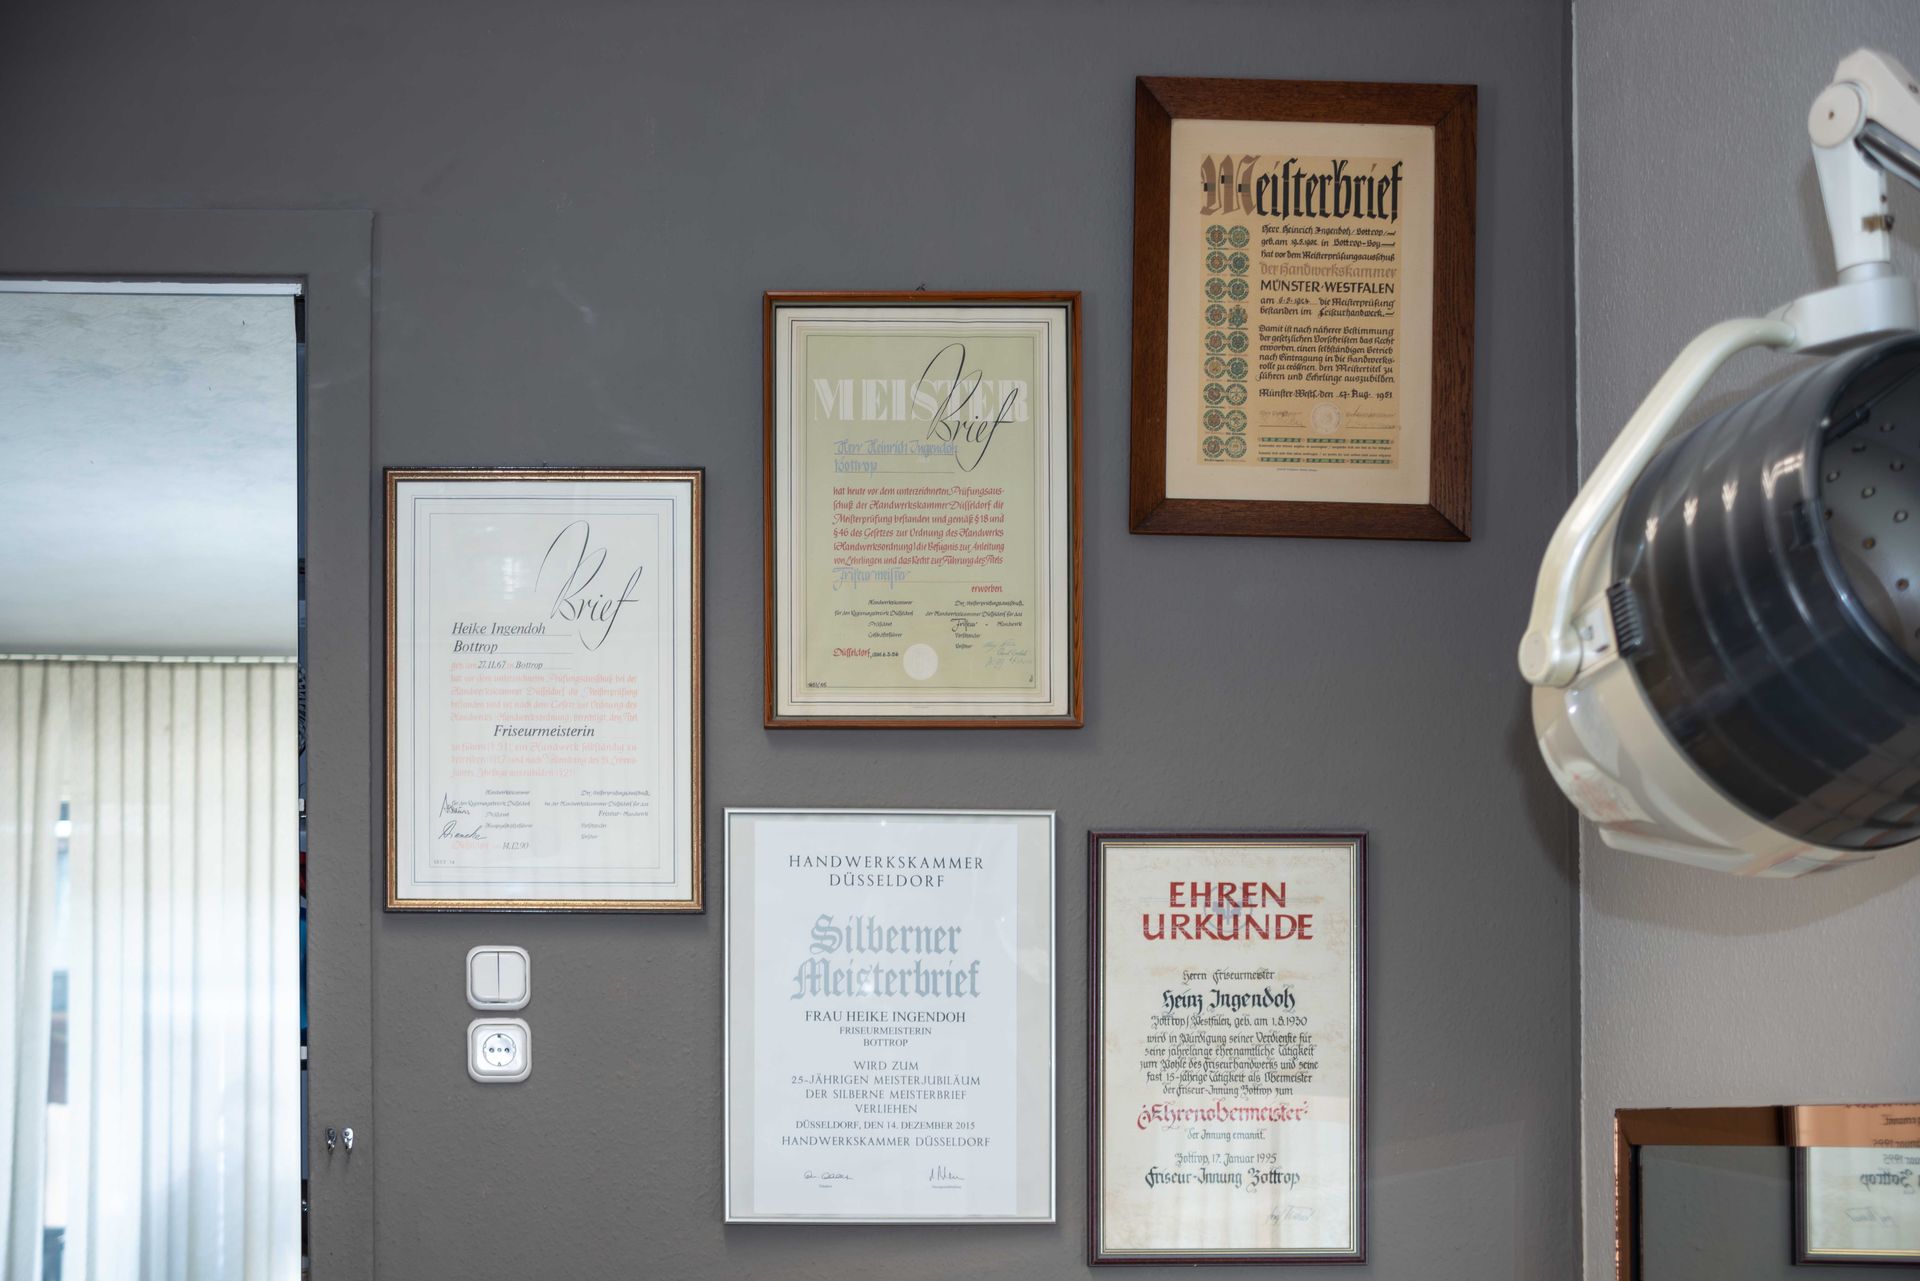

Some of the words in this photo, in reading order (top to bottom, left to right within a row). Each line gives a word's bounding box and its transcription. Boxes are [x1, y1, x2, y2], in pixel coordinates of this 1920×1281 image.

[1200, 155, 1403, 224] Meisterbrief
[1261, 250, 1273, 260] hat
[1260, 262, 1279, 274] der
[1280, 263, 1397, 277] Handwerkskammer
[1332, 299, 1395, 307] Meisterprüfung
[1301, 307, 1311, 315] im
[1294, 325, 1311, 335] nach
[1313, 326, 1341, 335] näherer
[1343, 327, 1394, 336] Bestimmung
[1271, 335, 1312, 344] gesetzlichen
[1314, 336, 1357, 344] Vorschriften
[1375, 337, 1394, 345] Recht
[1259, 354, 1277, 363] nach
[1279, 355, 1323, 363] Eintragung
[1257, 373, 1285, 381] führen
[813, 379, 1030, 422] MEISTER
[912, 343, 1018, 472] Brief
[833, 486, 845, 495] hat
[847, 486, 865, 495] heute
[879, 486, 895, 495] dem
[856, 500, 867, 509] der
[870, 500, 946, 511] Handwerkskammer
[947, 500, 991, 511] Düsseldorf
[993, 500, 1004, 509] die
[833, 514, 892, 525] Meisterprüfung
[894, 514, 930, 523] bestanden
[931, 514, 946, 523] und
[946, 514, 974, 525] gemäß
[989, 514, 1004, 523] und
[850, 528, 862, 536] des
[895, 530, 907, 539] zur
[909, 528, 944, 539] Ordnung
[946, 528, 958, 536] des
[958, 528, 1004, 536] Handwerks
[916, 542, 927, 550] die
[927, 542, 959, 553] Befugnis
[960, 544, 970, 553] zur
[535, 519, 643, 651] Brief
[452, 621, 487, 635] Heike
[490, 621, 546, 638] Ingendoh
[453, 640, 498, 656] Bottrop
[515, 660, 543, 672] Bottrop
[493, 724, 595, 737] Friseurmeisterin
[789, 856, 984, 869] HANDWERKSKAMMER
[829, 873, 945, 887] DÜSSELDORF
[1169, 882, 1286, 907] EHREN
[1142, 914, 1313, 940] URKUNDE
[809, 913, 962, 955] Silberner
[790, 957, 981, 1000] Meisterbrief
[1182, 968, 1207, 984] Herrn
[1212, 968, 1275, 984] Friseurmeister
[1162, 988, 1203, 1012] Heinz
[1207, 988, 1296, 1012] Ingendoh
[805, 1011, 842, 1022] FRAU
[846, 1011, 888, 1022] HEIKE
[892, 1011, 966, 1022] INGENDOH
[1254, 1018, 1268, 1026] am
[839, 1027, 932, 1035] FRISEURMEISTERIN
[863, 1038, 908, 1047] BOTTROP
[1147, 1032, 1166, 1043] wird
[1169, 1032, 1177, 1043] in
[1179, 1032, 1227, 1046] Würdigung
[1229, 1032, 1254, 1043] seiner
[1256, 1032, 1297, 1043] Verdienste
[1299, 1032, 1312, 1046] für
[1145, 1045, 1165, 1056] seine
[1167, 1045, 1213, 1058] jahrelange
[1215, 1045, 1275, 1058] ehrenamtliche
[1278, 1045, 1315, 1058] Tätigkeit
[853, 1061, 887, 1070] WIRD
[892, 1061, 919, 1070] ZUM
[1140, 1062, 1157, 1072] zum
[1160, 1060, 1186, 1072] Wohle
[1188, 1060, 1202, 1069] des
[1203, 1060, 1278, 1072] Friseurhandwerks
[1280, 1060, 1296, 1069] und
[1298, 1060, 1319, 1069] seine
[792, 1074, 869, 1084] 25-JÄHRIGEN
[874, 1074, 981, 1085] MEISTERJUBILÄUM
[1146, 1073, 1162, 1082] fast
[1208, 1073, 1246, 1084] Tätigkeit
[1248, 1073, 1261, 1082] als
[1264, 1073, 1313, 1082] Obermeister
[805, 1089, 828, 1099] DER
[833, 1090, 884, 1099] SILBERNE
[889, 1090, 967, 1099] MEISTERBRIEF
[1162, 1086, 1175, 1095] der
[1240, 1086, 1273, 1097] Bottrop
[1275, 1089, 1293, 1097] zum
[855, 1104, 918, 1113] VERLIEHEN
[795, 1120, 861, 1129] DÜSSELDORF,
[864, 1120, 883, 1129] DEN
[886, 1120, 899, 1129] 14.
[901, 1120, 953, 1130] DEZEMBER
[956, 1120, 976, 1130] 2015
[782, 1136, 910, 1146] HANDWERKSKAMMER
[915, 1137, 991, 1146] DÜSSELDORF
[1187, 1129, 1199, 1139] der
[1201, 1129, 1231, 1142] Innung
[1223, 1153, 1254, 1166] Januar
[1256, 1153, 1277, 1164] 1995
[1145, 1168, 1243, 1188] Friseur-Innung
[1247, 1168, 1301, 1191] Bottrop
